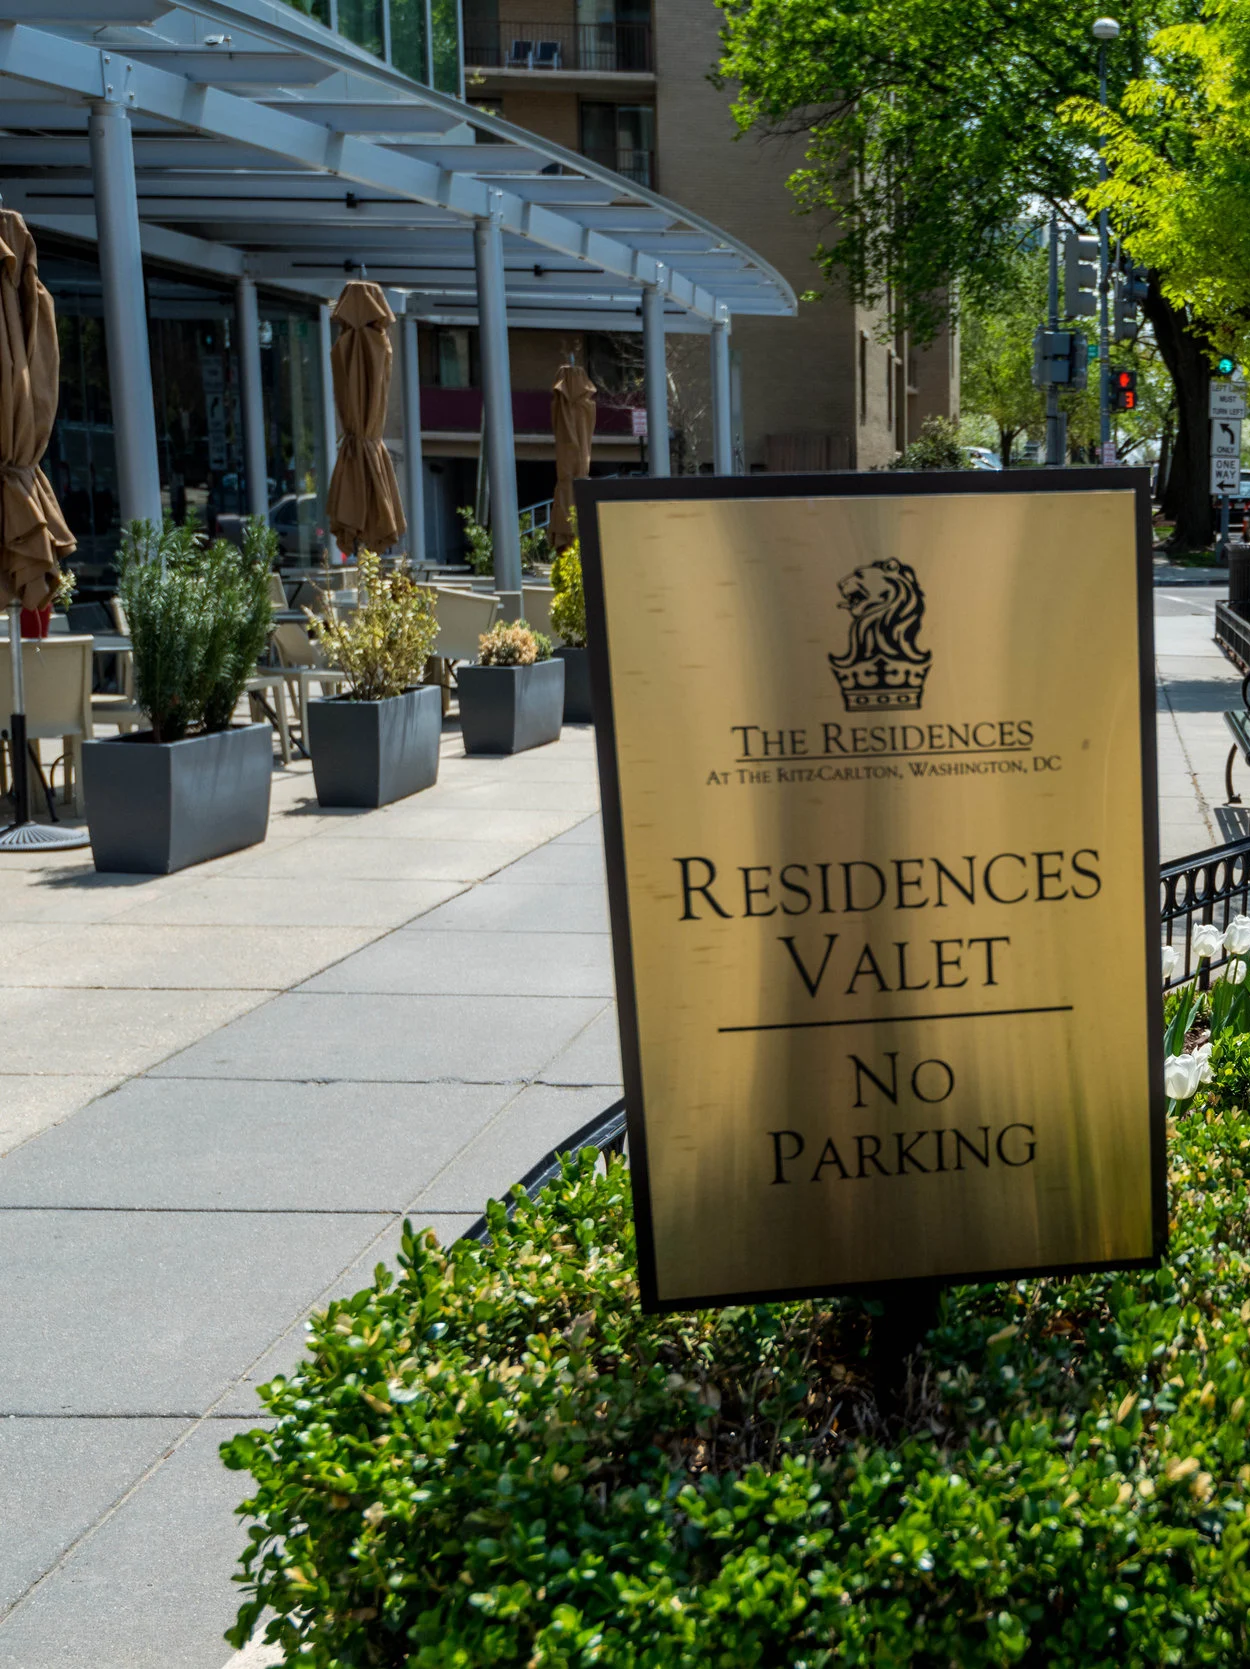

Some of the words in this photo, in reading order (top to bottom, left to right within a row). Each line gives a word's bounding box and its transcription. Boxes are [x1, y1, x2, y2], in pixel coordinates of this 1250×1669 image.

[1125, 391, 1134, 408] 3
[1216, 460, 1235, 469] ONE
[1216, 471, 1236, 480] WAY
[822, 720, 1035, 754] RESIDENCES
[706, 770, 732, 786] AT
[737, 768, 773, 785] THE
[908, 758, 1029, 779] WASHINGTON,
[1033, 755, 1063, 772] DC
[672, 848, 1102, 921] RESIDENCES
[777, 933, 1011, 999] VALET
[847, 1051, 955, 1109] NO
[768, 1122, 1038, 1186] PARKING
